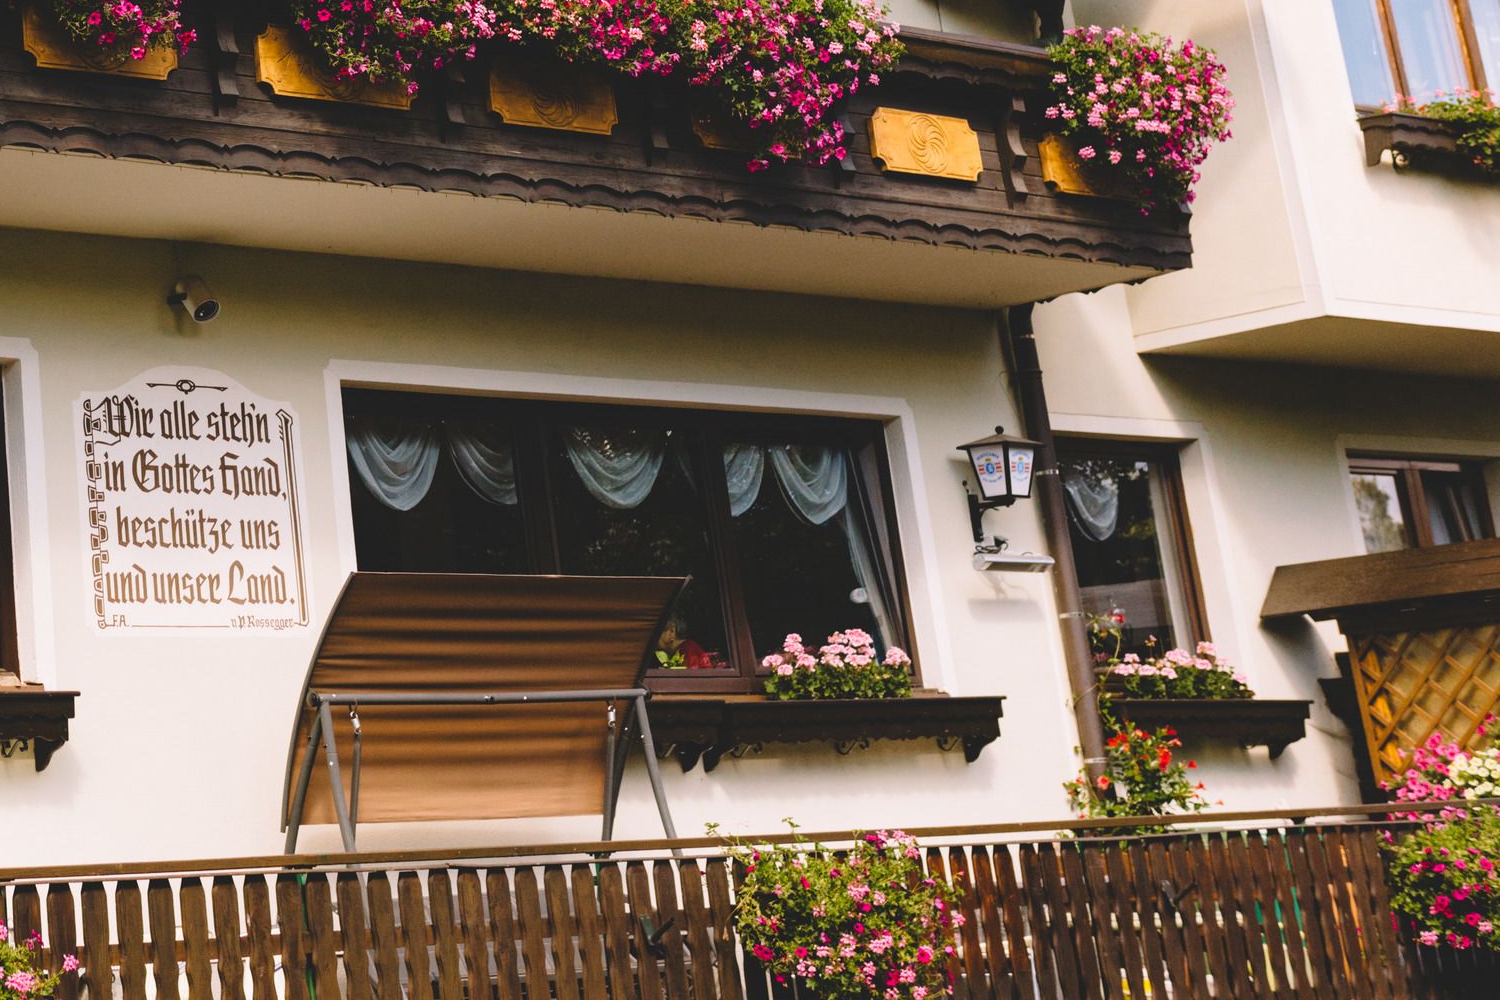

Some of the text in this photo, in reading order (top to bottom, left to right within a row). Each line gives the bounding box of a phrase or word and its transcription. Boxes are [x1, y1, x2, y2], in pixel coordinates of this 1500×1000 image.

[102, 394, 155, 440] Wir
[159, 400, 201, 441] alle
[104, 449, 287, 501] in Gottes Hand,
[116, 506, 281, 555] beschütze uns
[105, 559, 296, 606] und unser Land.
